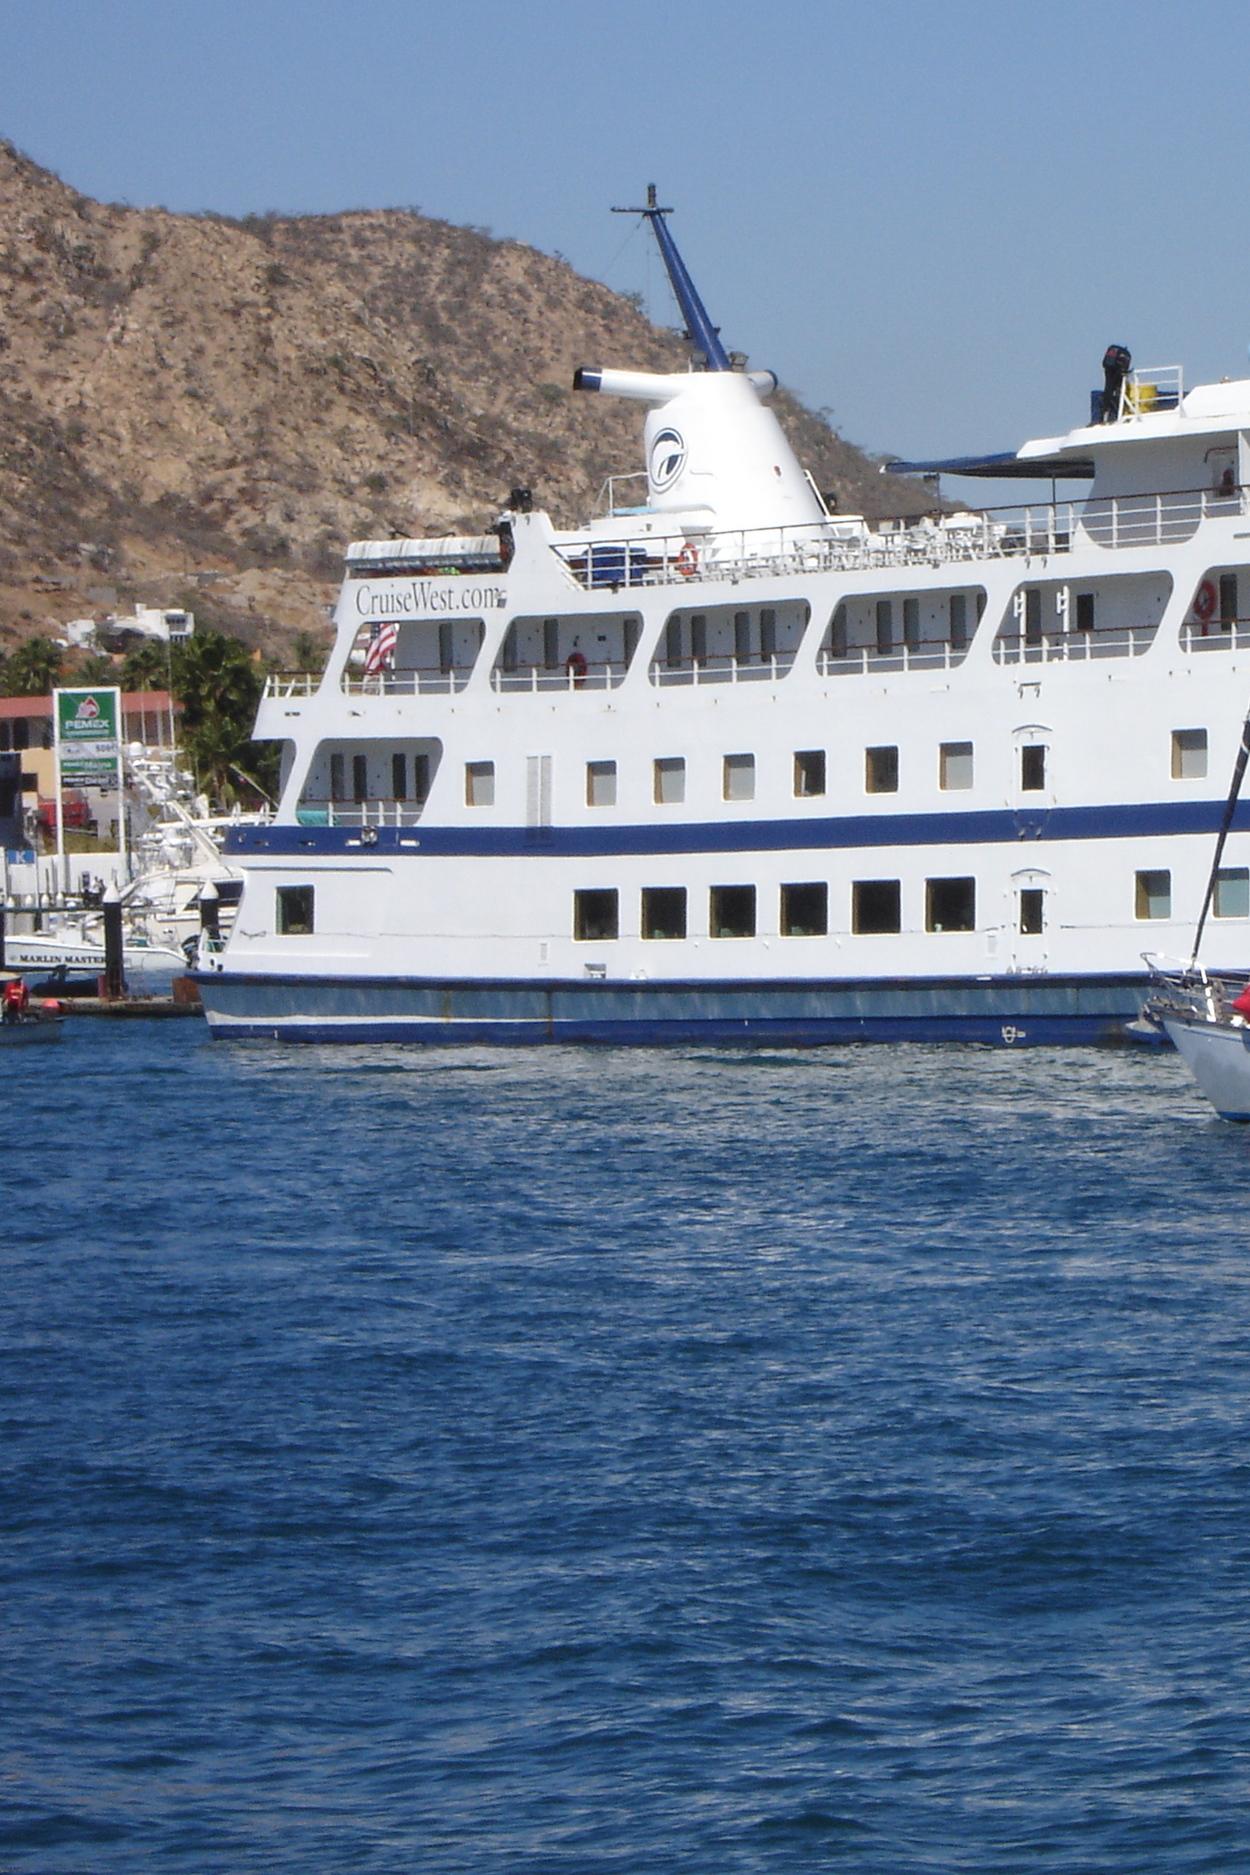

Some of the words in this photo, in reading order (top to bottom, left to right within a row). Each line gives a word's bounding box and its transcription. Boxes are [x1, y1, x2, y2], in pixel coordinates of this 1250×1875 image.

[356, 581, 500, 616] CruiseWest.com
[65, 720, 110, 730] PEMEX
[16, 850, 27, 864] K
[20, 954, 62, 964] MARLIN
